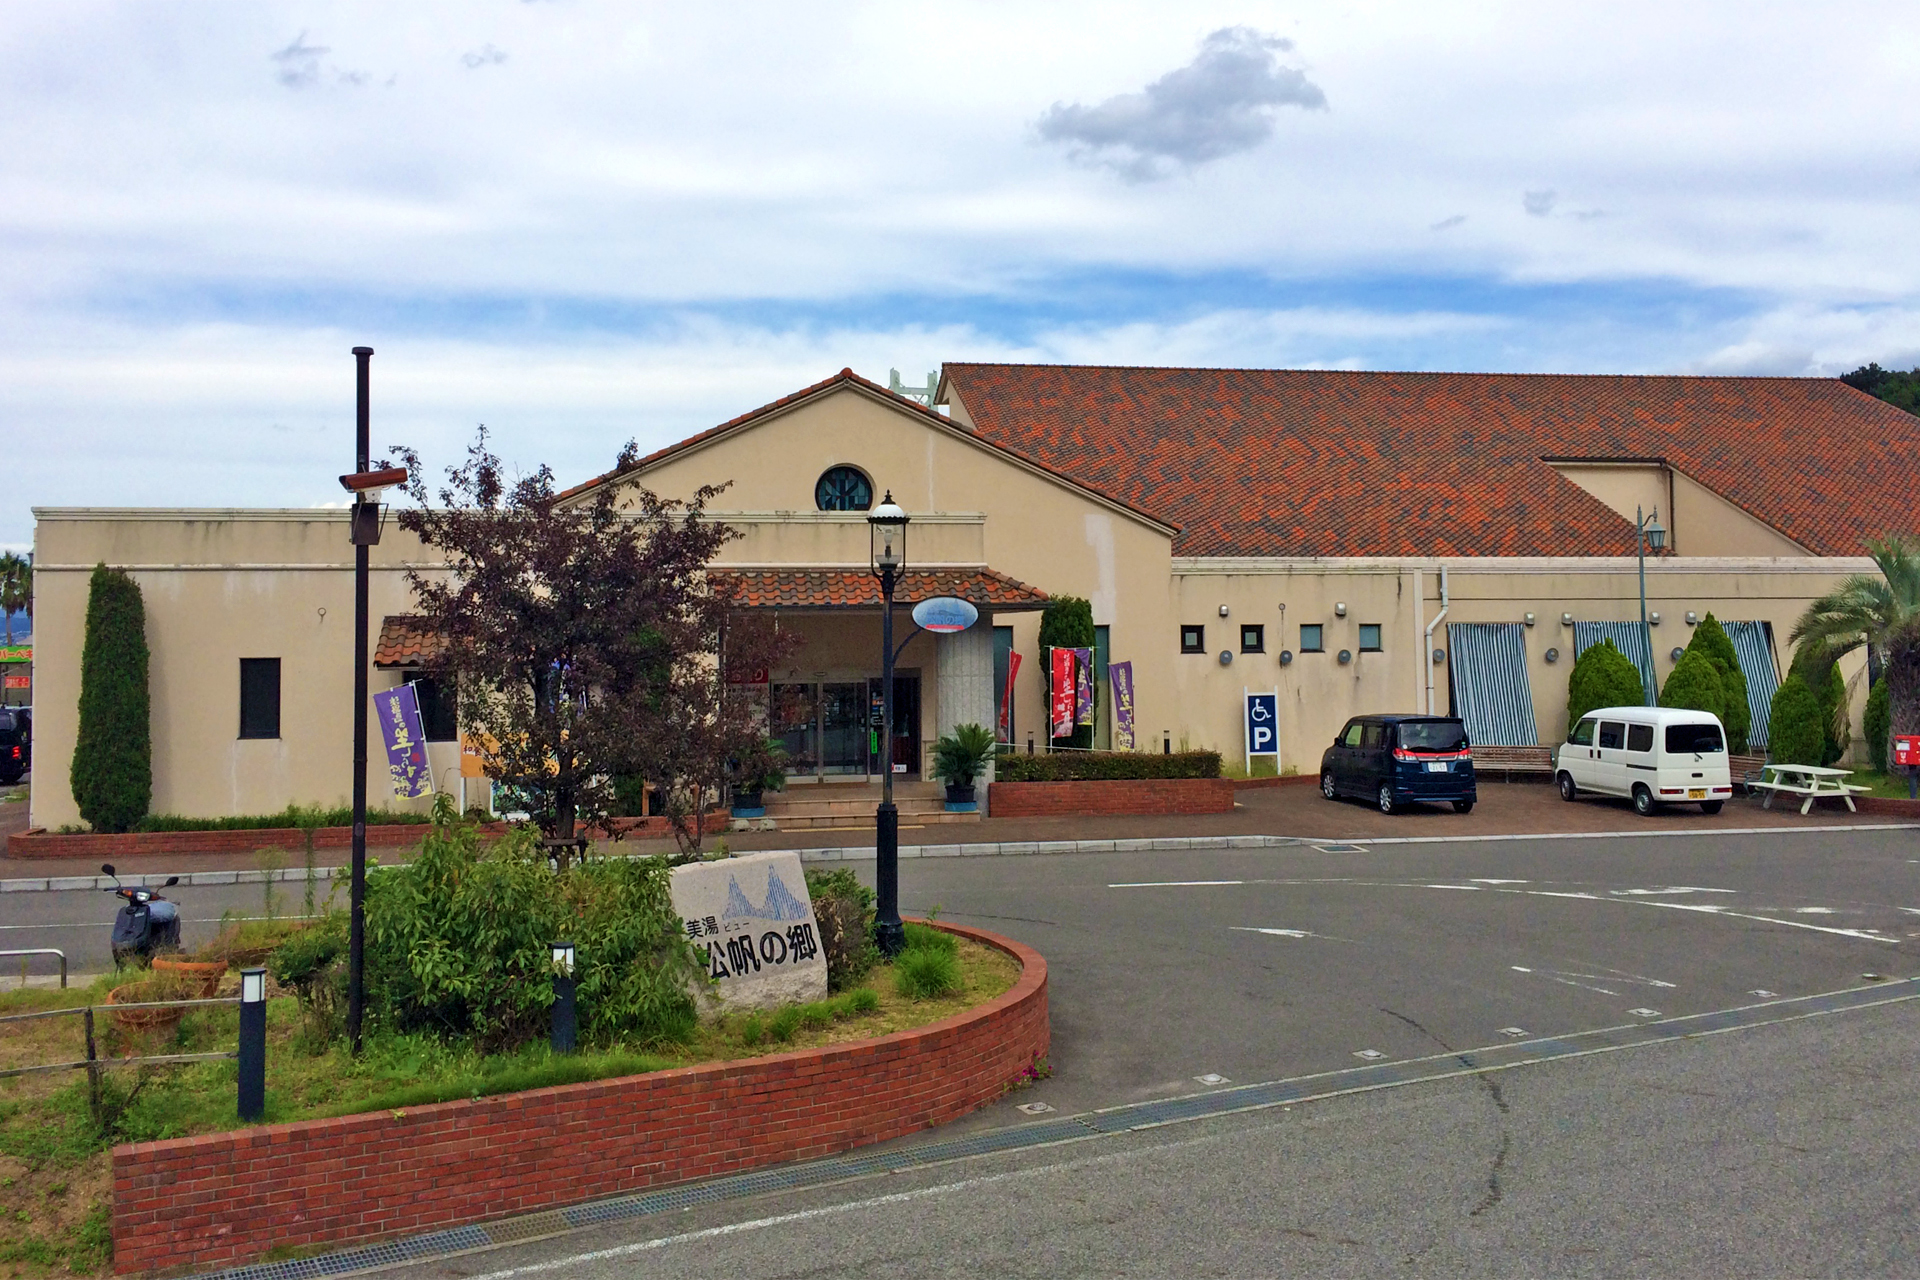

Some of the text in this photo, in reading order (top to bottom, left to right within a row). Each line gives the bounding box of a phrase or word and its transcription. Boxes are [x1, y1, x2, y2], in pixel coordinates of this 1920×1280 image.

[1254, 726, 1272, 750] P
[686, 915, 750, 939] 美湯 ビュー
